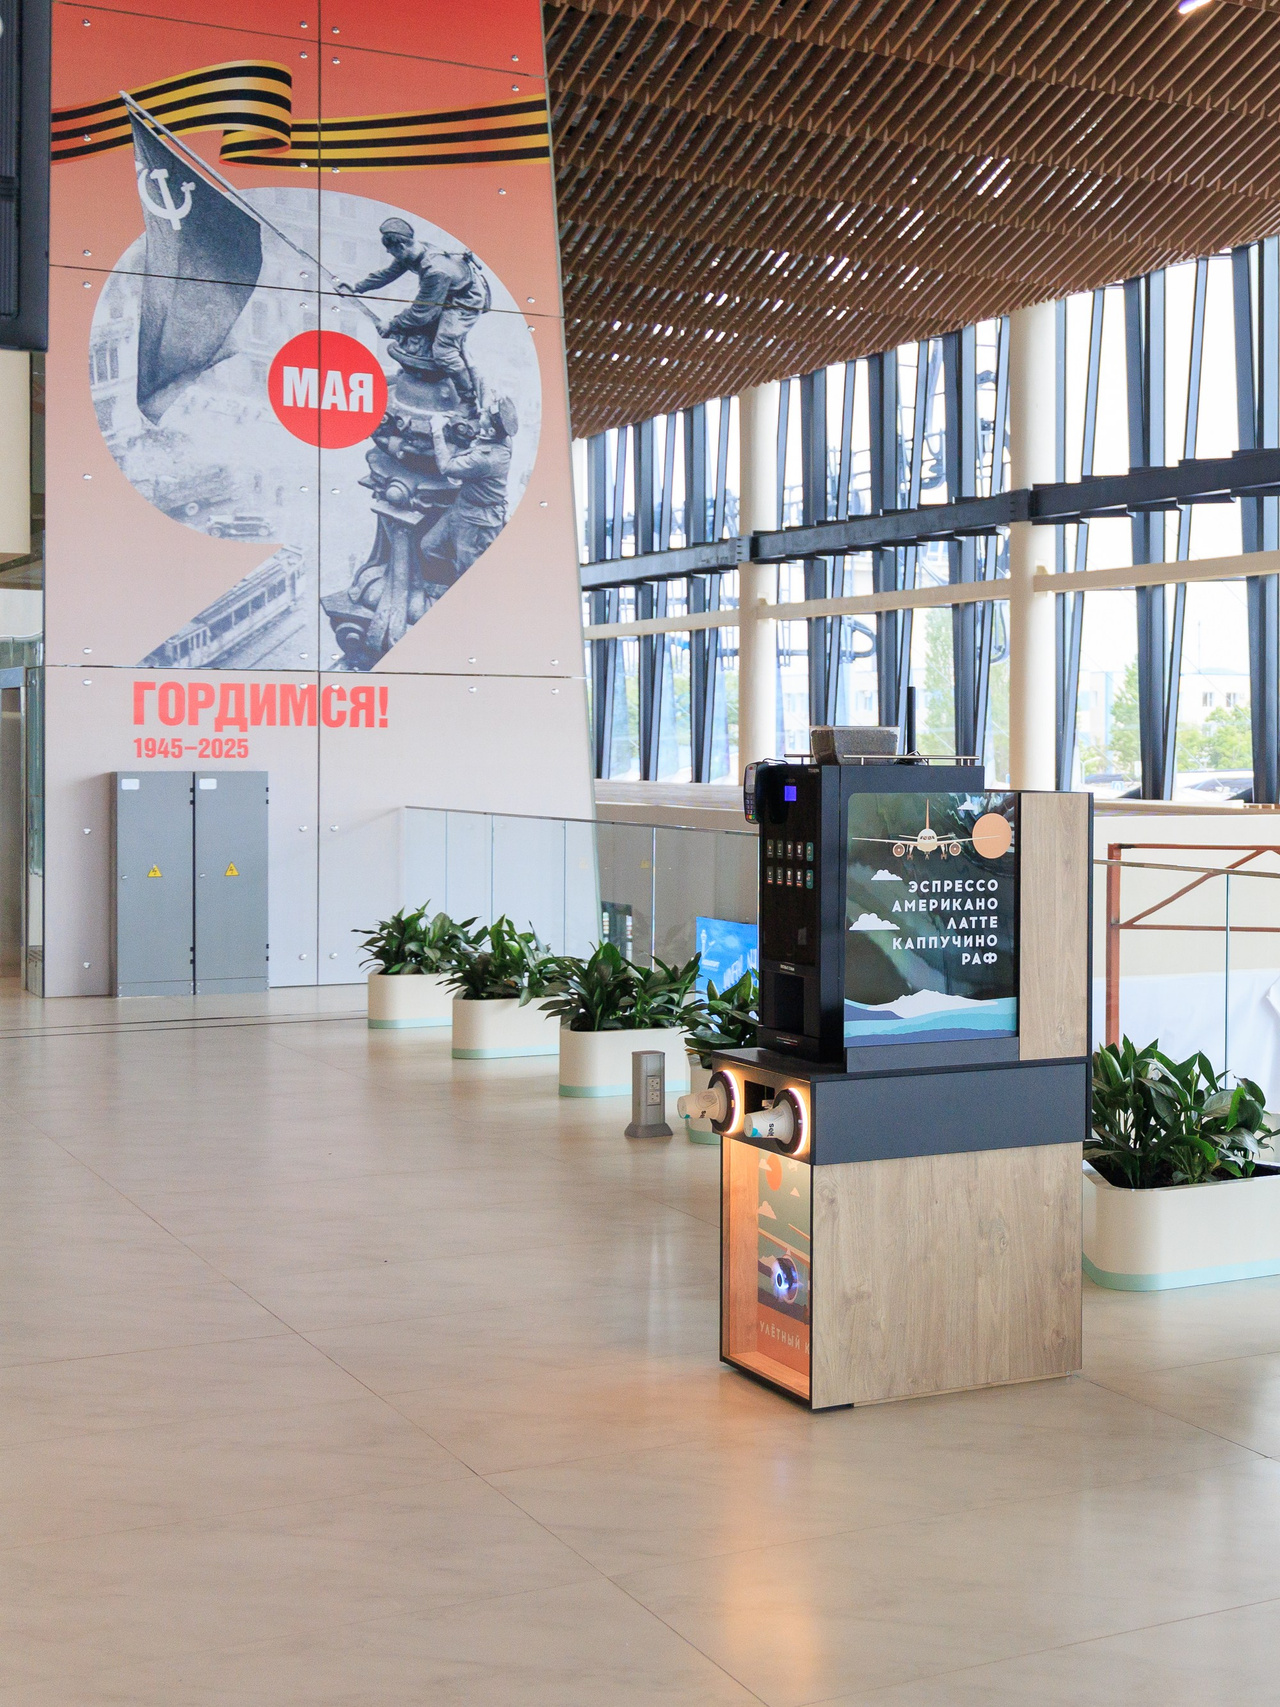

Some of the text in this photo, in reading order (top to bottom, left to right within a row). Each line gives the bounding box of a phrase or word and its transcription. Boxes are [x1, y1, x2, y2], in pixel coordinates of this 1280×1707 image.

[283, 366, 374, 413] МАЯ
[133, 681, 389, 732] ГОРДИМСЯ!
[908, 879, 999, 893] ЭСПРЕССО
[891, 897, 999, 912] АМЕРИКАНО
[946, 916, 998, 930] ЛАТТЕ
[892, 934, 998, 950] КАППУЧИНО
[961, 952, 998, 966] РАФ
[760, 1320, 801, 1350] УЛЁТНЫЙ
